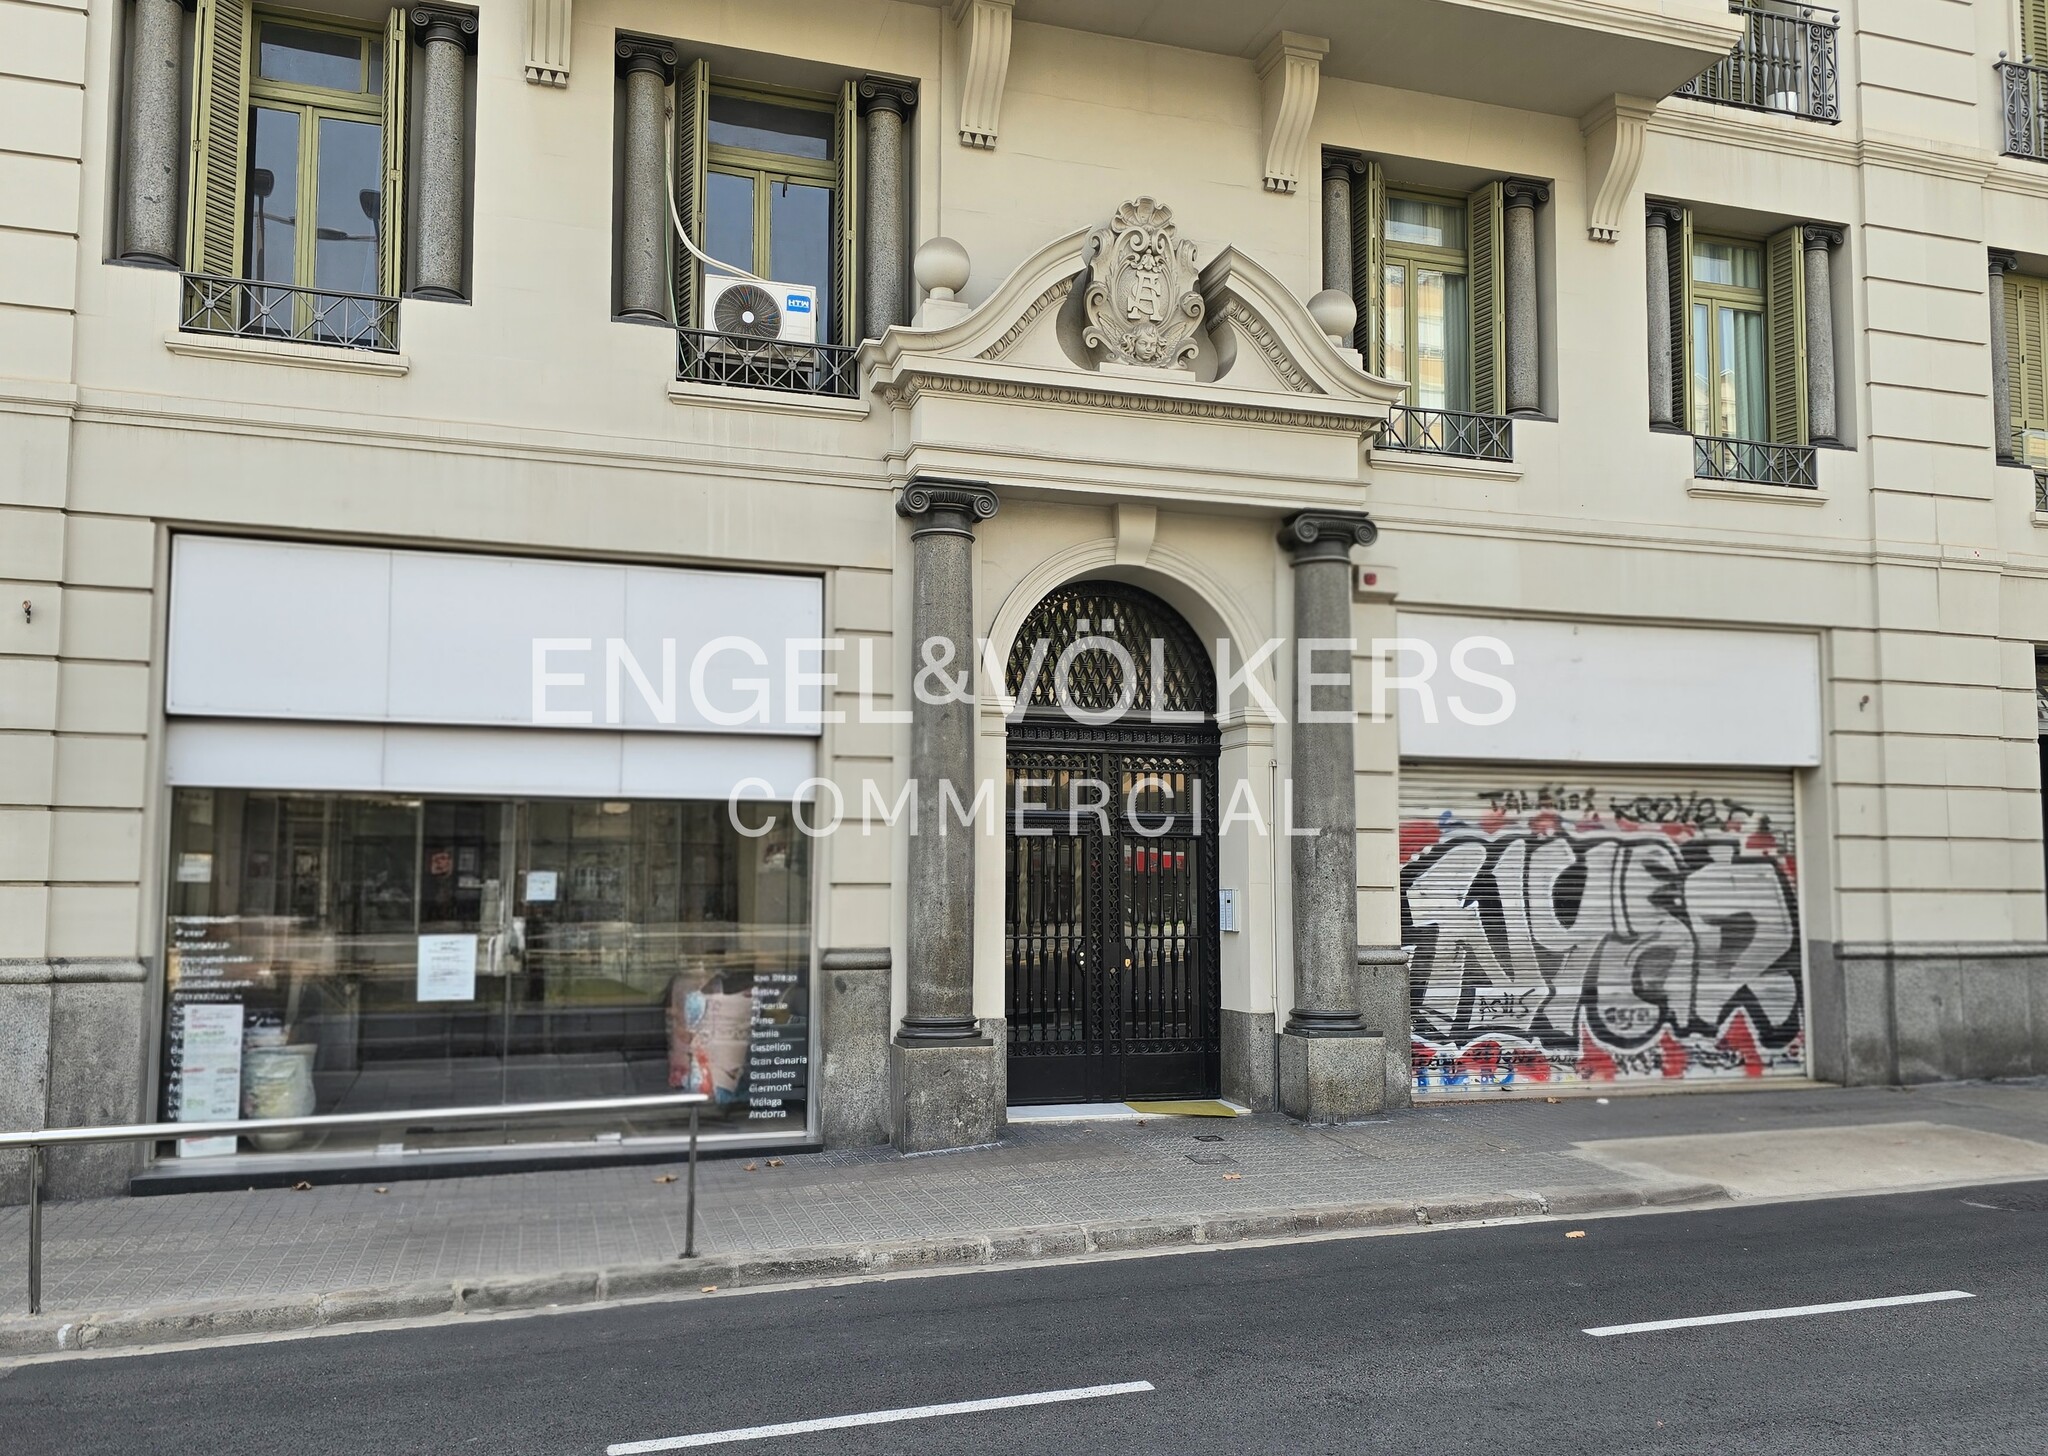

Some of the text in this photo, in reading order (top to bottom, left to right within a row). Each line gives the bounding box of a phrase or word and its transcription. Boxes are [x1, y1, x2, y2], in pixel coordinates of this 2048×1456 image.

[788, 299, 809, 308] HTW
[751, 1042, 792, 1052] Castellón
[751, 1056, 807, 1066] Gran Canaria
[750, 1069, 796, 1080] Granollers
[750, 1097, 782, 1107] Málaga
[749, 1109, 787, 1119] Andorra
